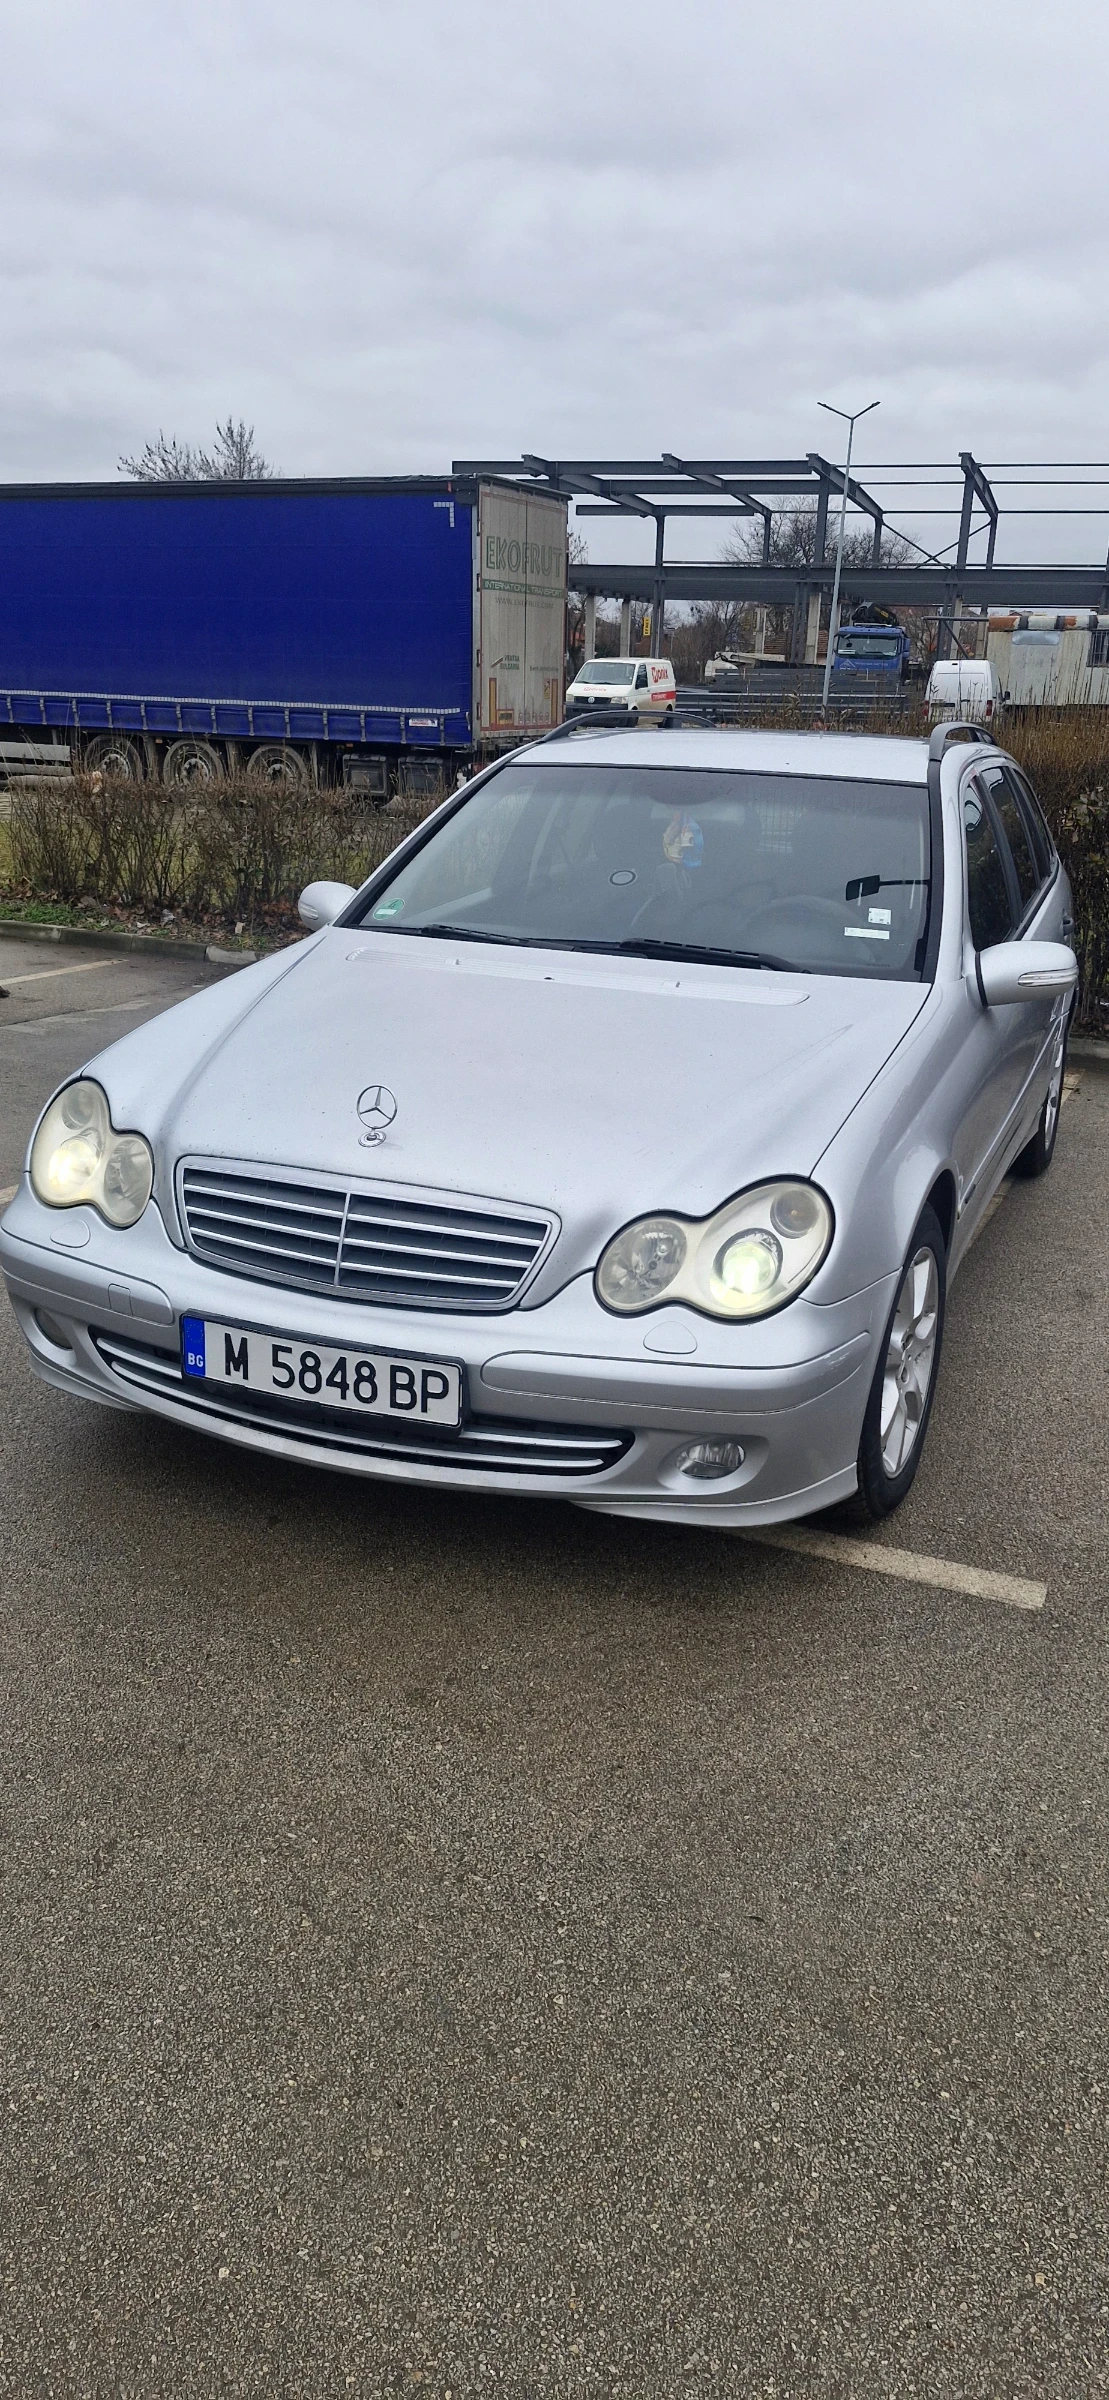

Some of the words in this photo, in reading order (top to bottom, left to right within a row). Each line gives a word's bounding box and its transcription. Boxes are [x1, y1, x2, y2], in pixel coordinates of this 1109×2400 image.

[486, 535, 563, 578] EKOFRUT
[484, 580, 530, 593] INTERNATIONAL
[531, 586, 563, 597] TRANSPORT
[187, 1351, 204, 1368] BG
[224, 1332, 249, 1380] M
[271, 1343, 378, 1404] 5848
[389, 1364, 449, 1413] BP
